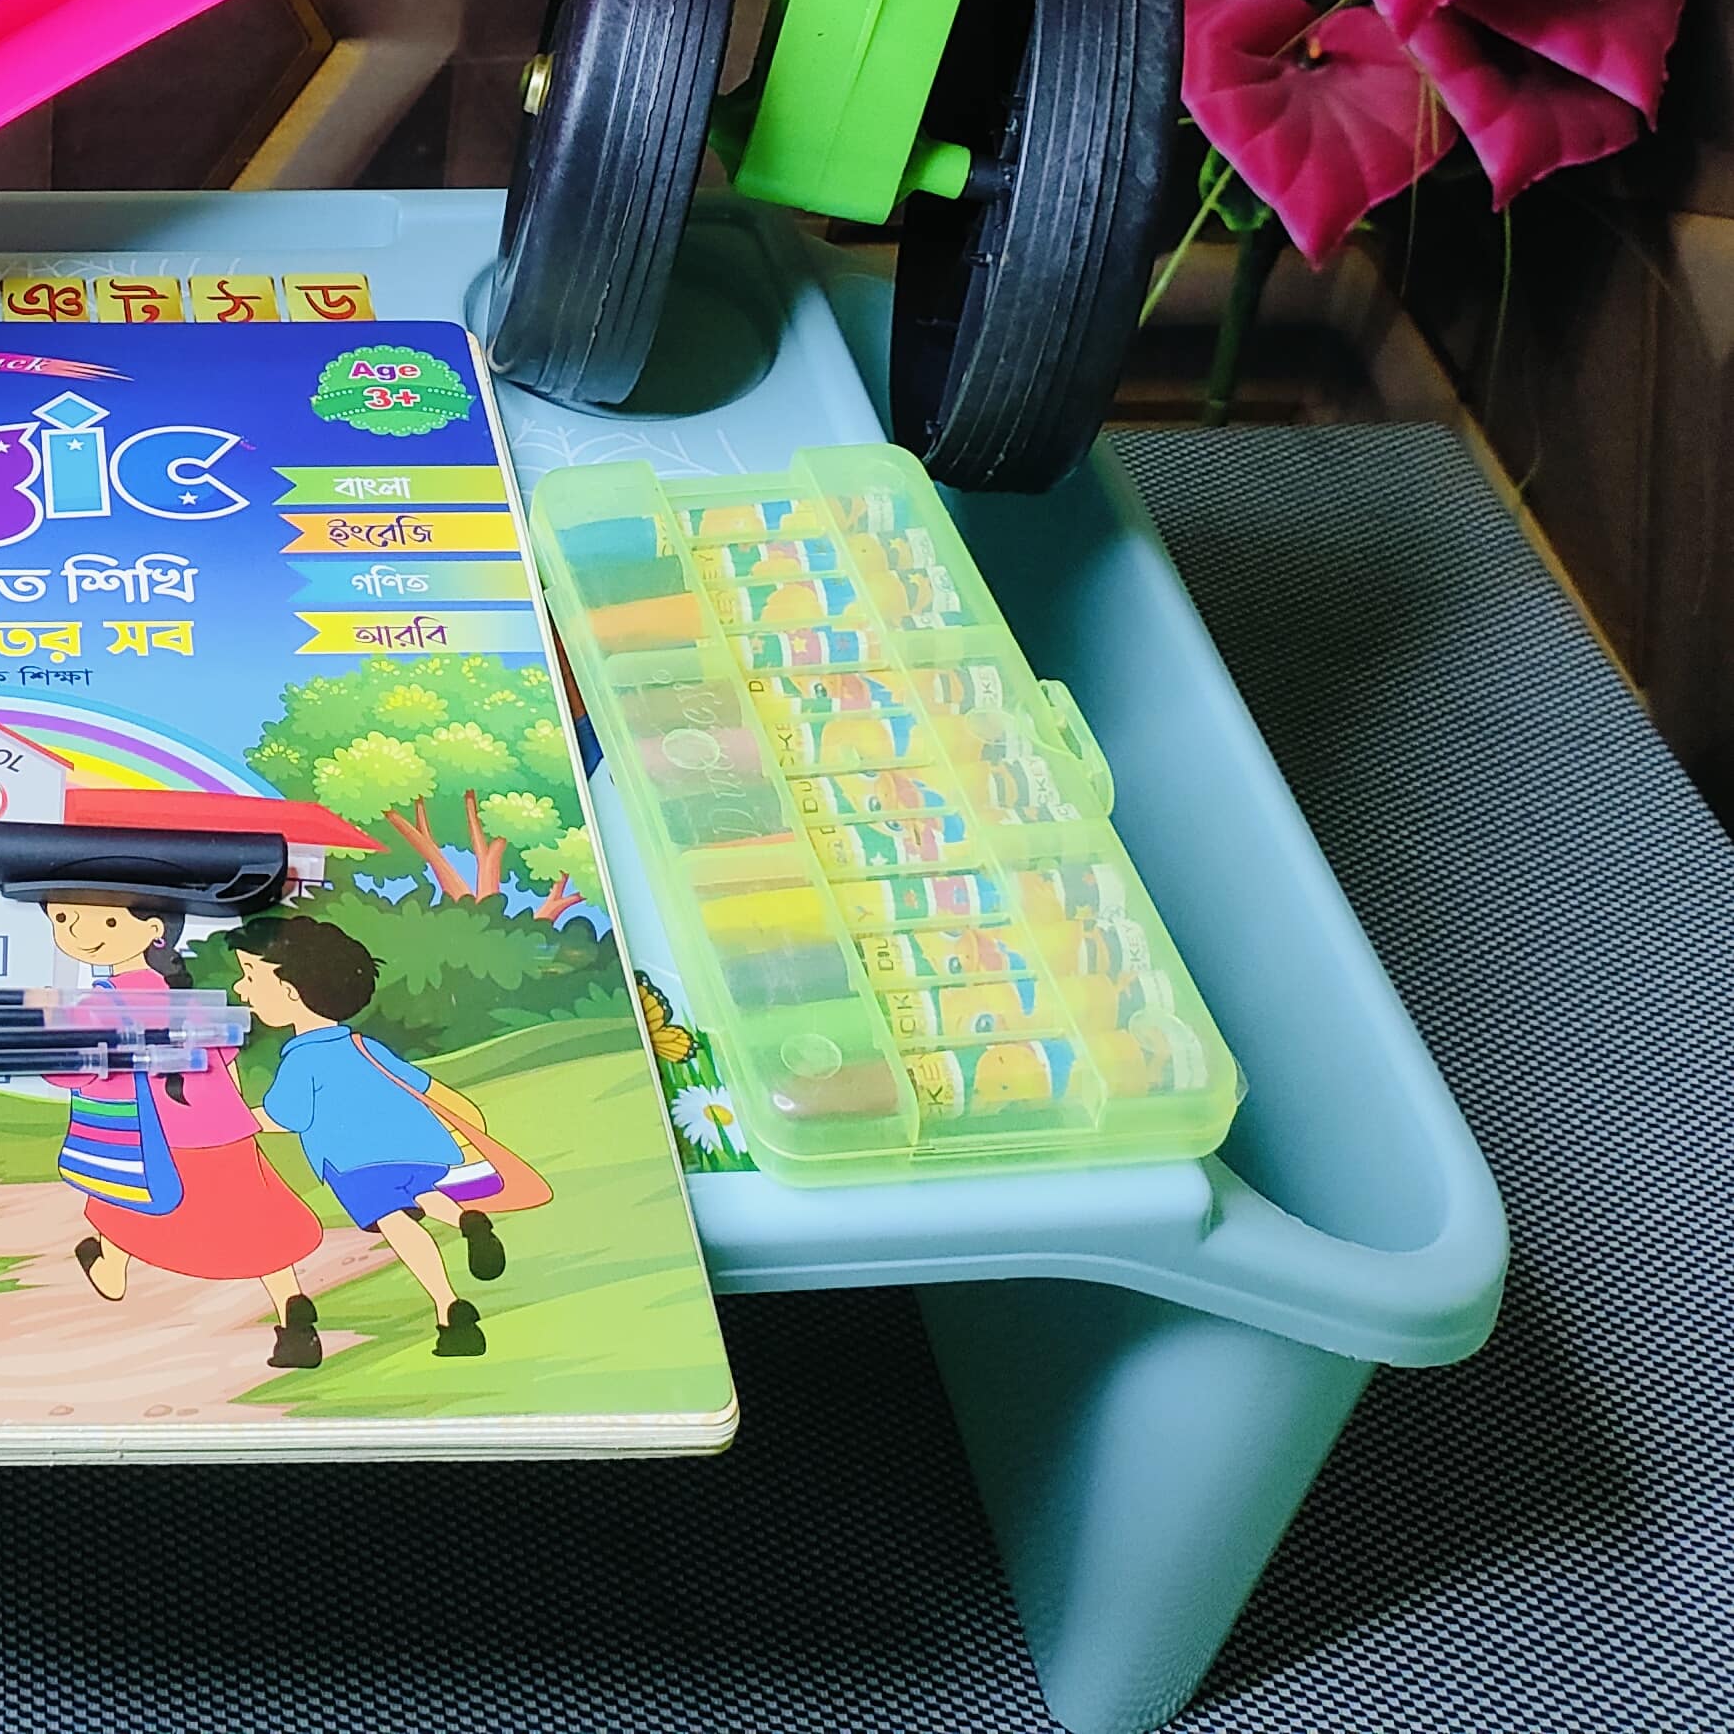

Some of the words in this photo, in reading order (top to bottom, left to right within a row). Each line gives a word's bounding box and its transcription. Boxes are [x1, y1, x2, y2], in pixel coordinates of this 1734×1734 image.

[8, 282, 83, 322] ঞ
[109, 278, 169, 323] ট
[206, 279, 262, 323] ঠ
[295, 284, 363, 320] ড
[351, 361, 421, 384] Age
[363, 386, 421, 410] 3+
[333, 476, 411, 500] বাংলা
[328, 515, 434, 548] ইংরেজি
[61, 553, 199, 604] শিখি
[351, 564, 430, 598] গণিত
[103, 619, 195, 657] সব
[352, 616, 448, 649] আরবি
[18, 667, 94, 688] শিক্ষা
